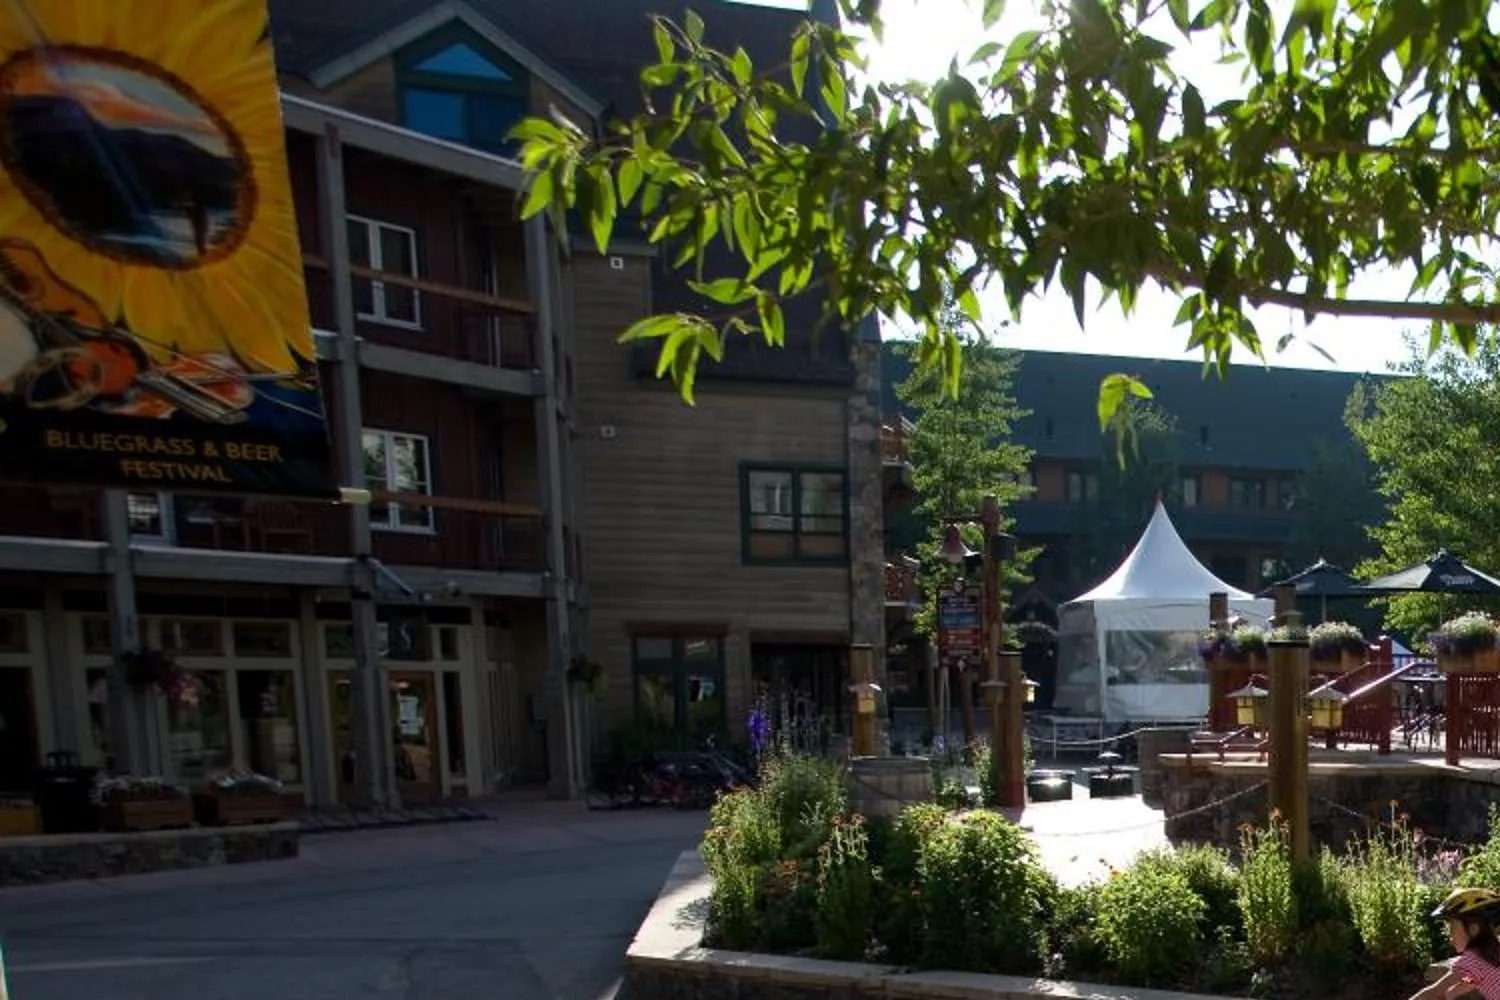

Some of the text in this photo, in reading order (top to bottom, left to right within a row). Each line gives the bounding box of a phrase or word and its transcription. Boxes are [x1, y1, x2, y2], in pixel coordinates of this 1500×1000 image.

[45, 429, 285, 463] BLUEGRASS & BEER
[120, 459, 234, 483] FESTIVAL
